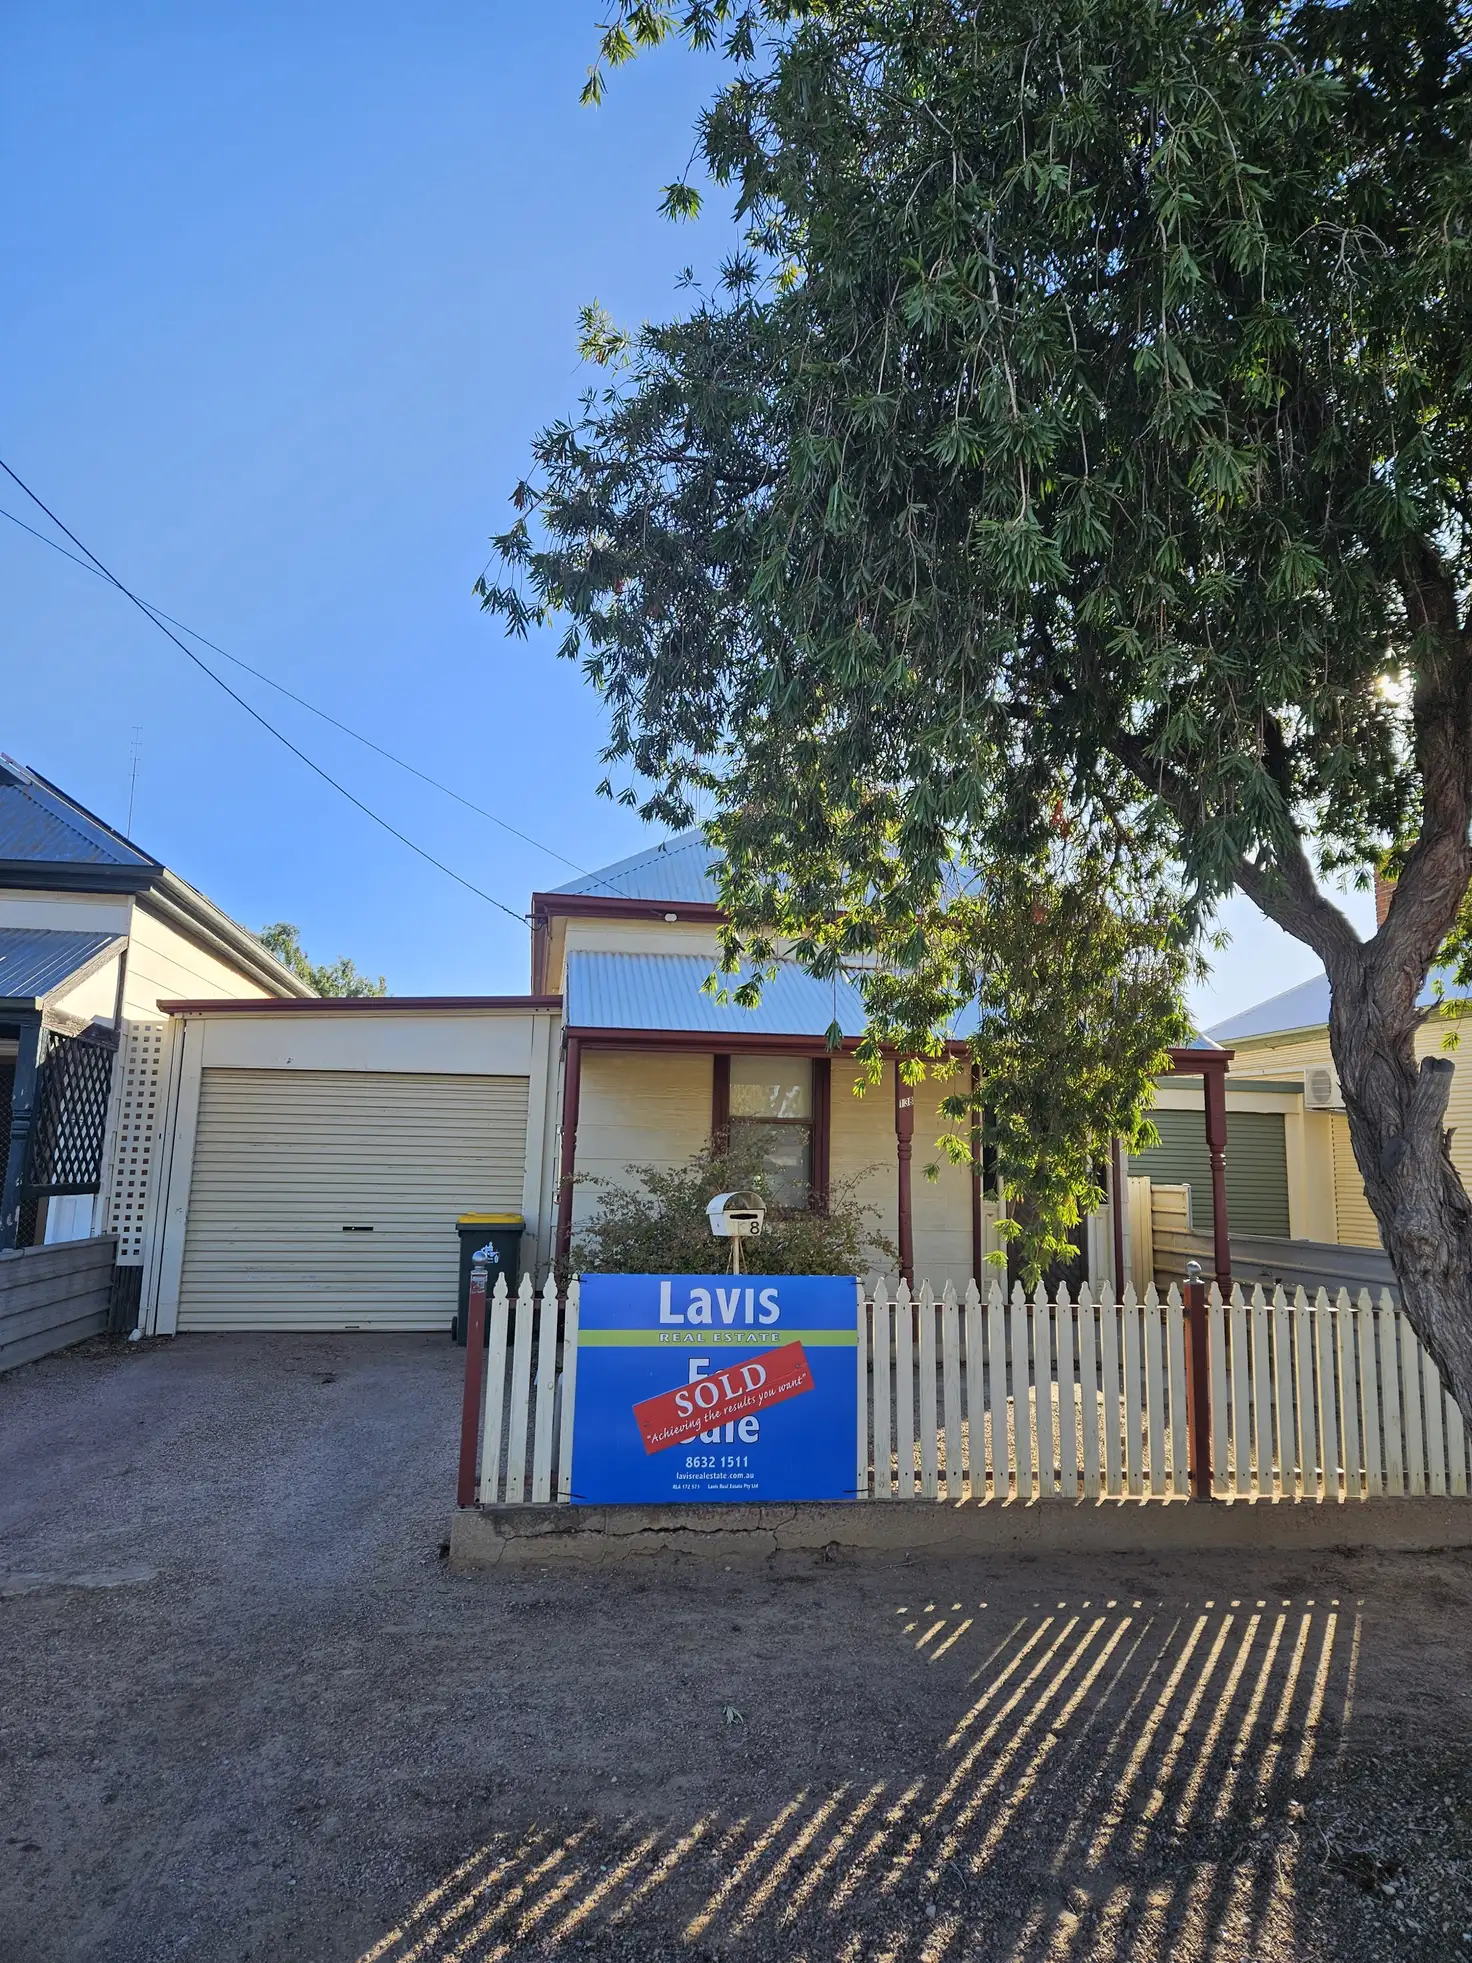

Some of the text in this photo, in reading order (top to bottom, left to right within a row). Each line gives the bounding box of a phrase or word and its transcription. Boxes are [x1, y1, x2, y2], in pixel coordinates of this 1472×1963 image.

[750, 1221, 760, 1235] 8
[659, 1332, 780, 1343] REAL ESTATE
[675, 1363, 767, 1418] SOLD
[704, 1409, 722, 1423] the
[724, 1395, 756, 1416] results
[757, 1389, 776, 1407] you
[685, 1456, 748, 1468] 8632 1511
[676, 1472, 754, 1480] lavisrealestate.com.au
